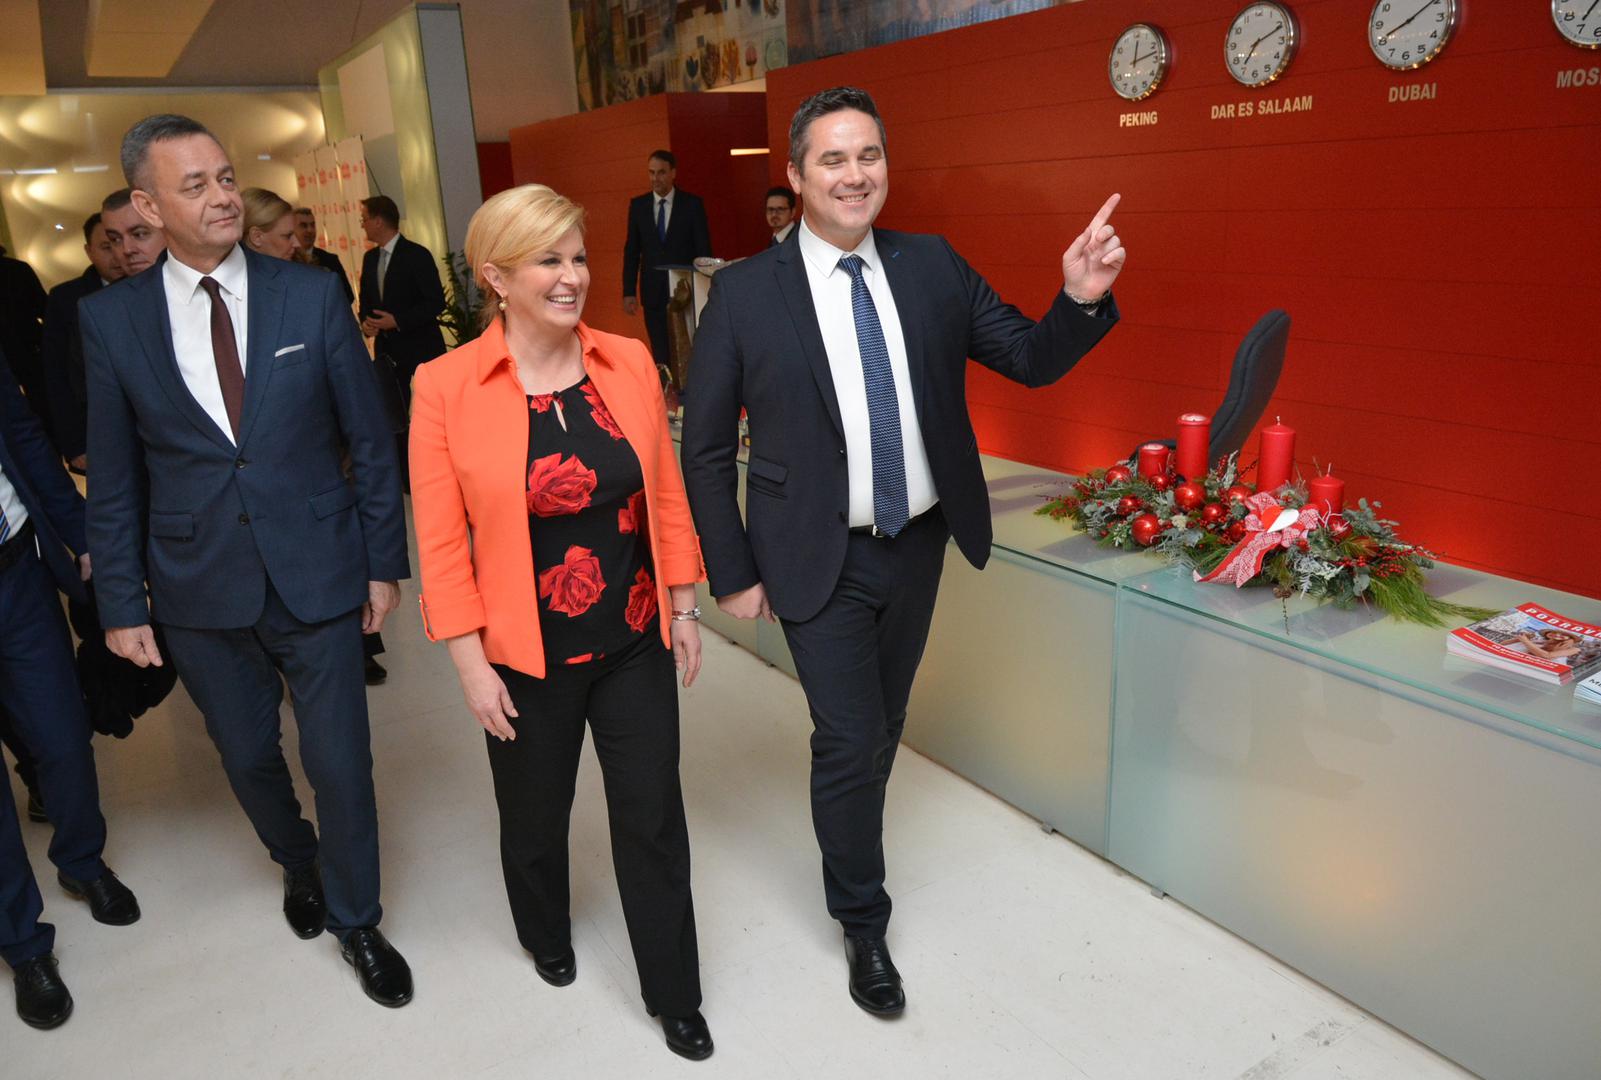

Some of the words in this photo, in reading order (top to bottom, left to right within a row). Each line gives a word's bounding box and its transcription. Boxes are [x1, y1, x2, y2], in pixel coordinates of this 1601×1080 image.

[1382, 4, 1390, 12] 10
[1436, 12, 1445, 22] 3
[1564, 11, 1575, 22] 8
[1375, 21, 1384, 30] 9
[1576, 24, 1586, 34] 7
[1235, 27, 1242, 35] 10
[1430, 30, 1438, 38] 4
[1593, 26, 1601, 38] 6
[1278, 36, 1284, 45] 3
[1378, 37, 1387, 46] 8
[1230, 42, 1237, 50] 9
[1417, 44, 1426, 54] 5
[1388, 48, 1396, 57] 7
[1402, 51, 1410, 60] 6
[1233, 57, 1240, 65] 8
[1241, 67, 1247, 75] 7
[1264, 64, 1271, 72] 5
[1252, 70, 1258, 78] 6
[1556, 66, 1601, 89] MOS
[1388, 82, 1438, 104] DUBAI
[1211, 104, 1236, 120] DAR
[1238, 101, 1254, 117] ES
[1257, 95, 1313, 116] SALAAM
[1119, 111, 1158, 128] PEKING
